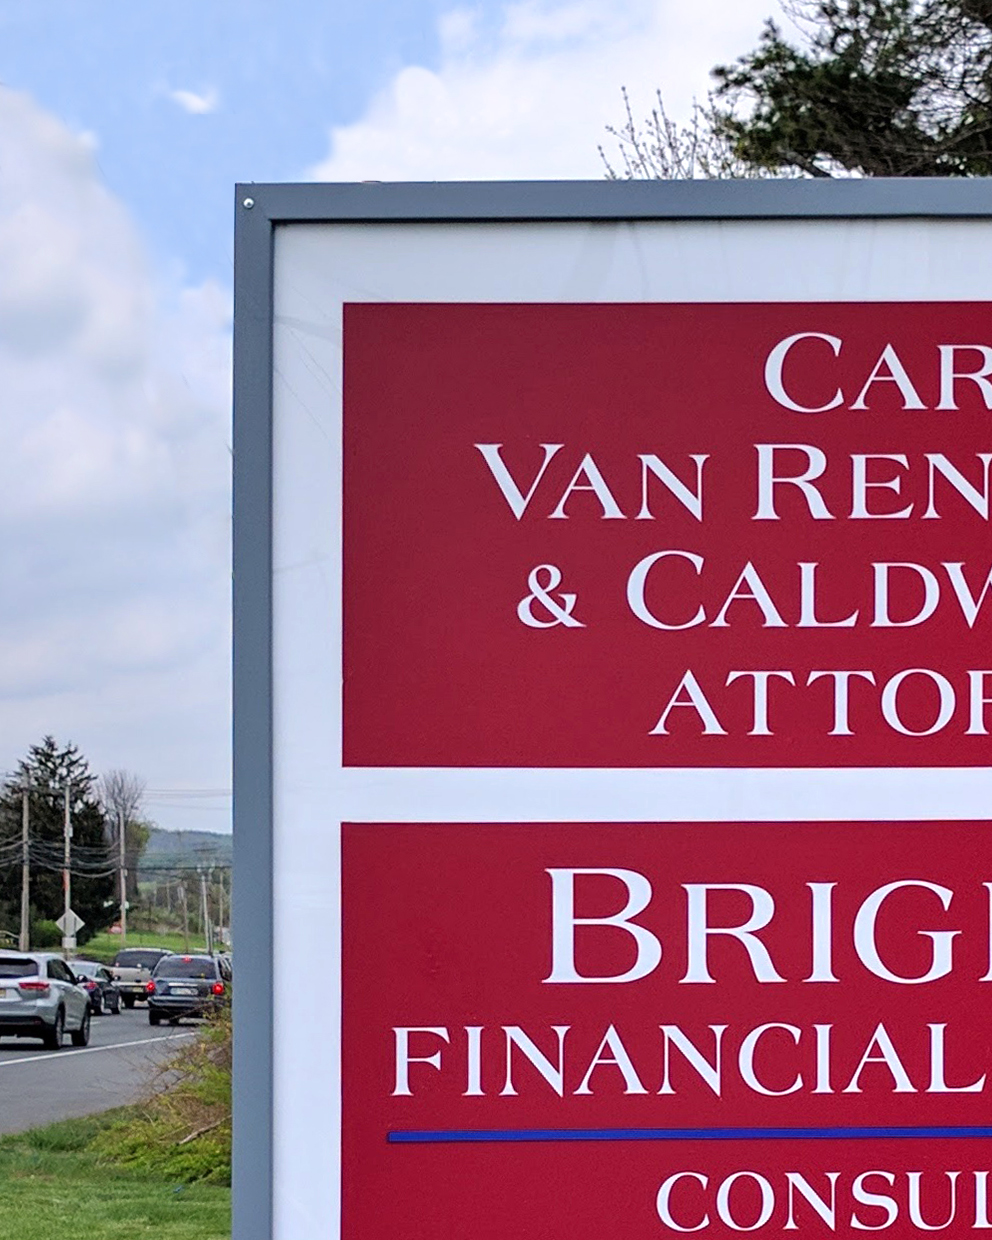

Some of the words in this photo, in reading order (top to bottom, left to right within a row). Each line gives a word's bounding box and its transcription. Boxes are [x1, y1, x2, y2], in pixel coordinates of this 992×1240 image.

[474, 443, 710, 522] VAN
[517, 564, 586, 628] &
[391, 1022, 987, 1098] FINANCIAL
